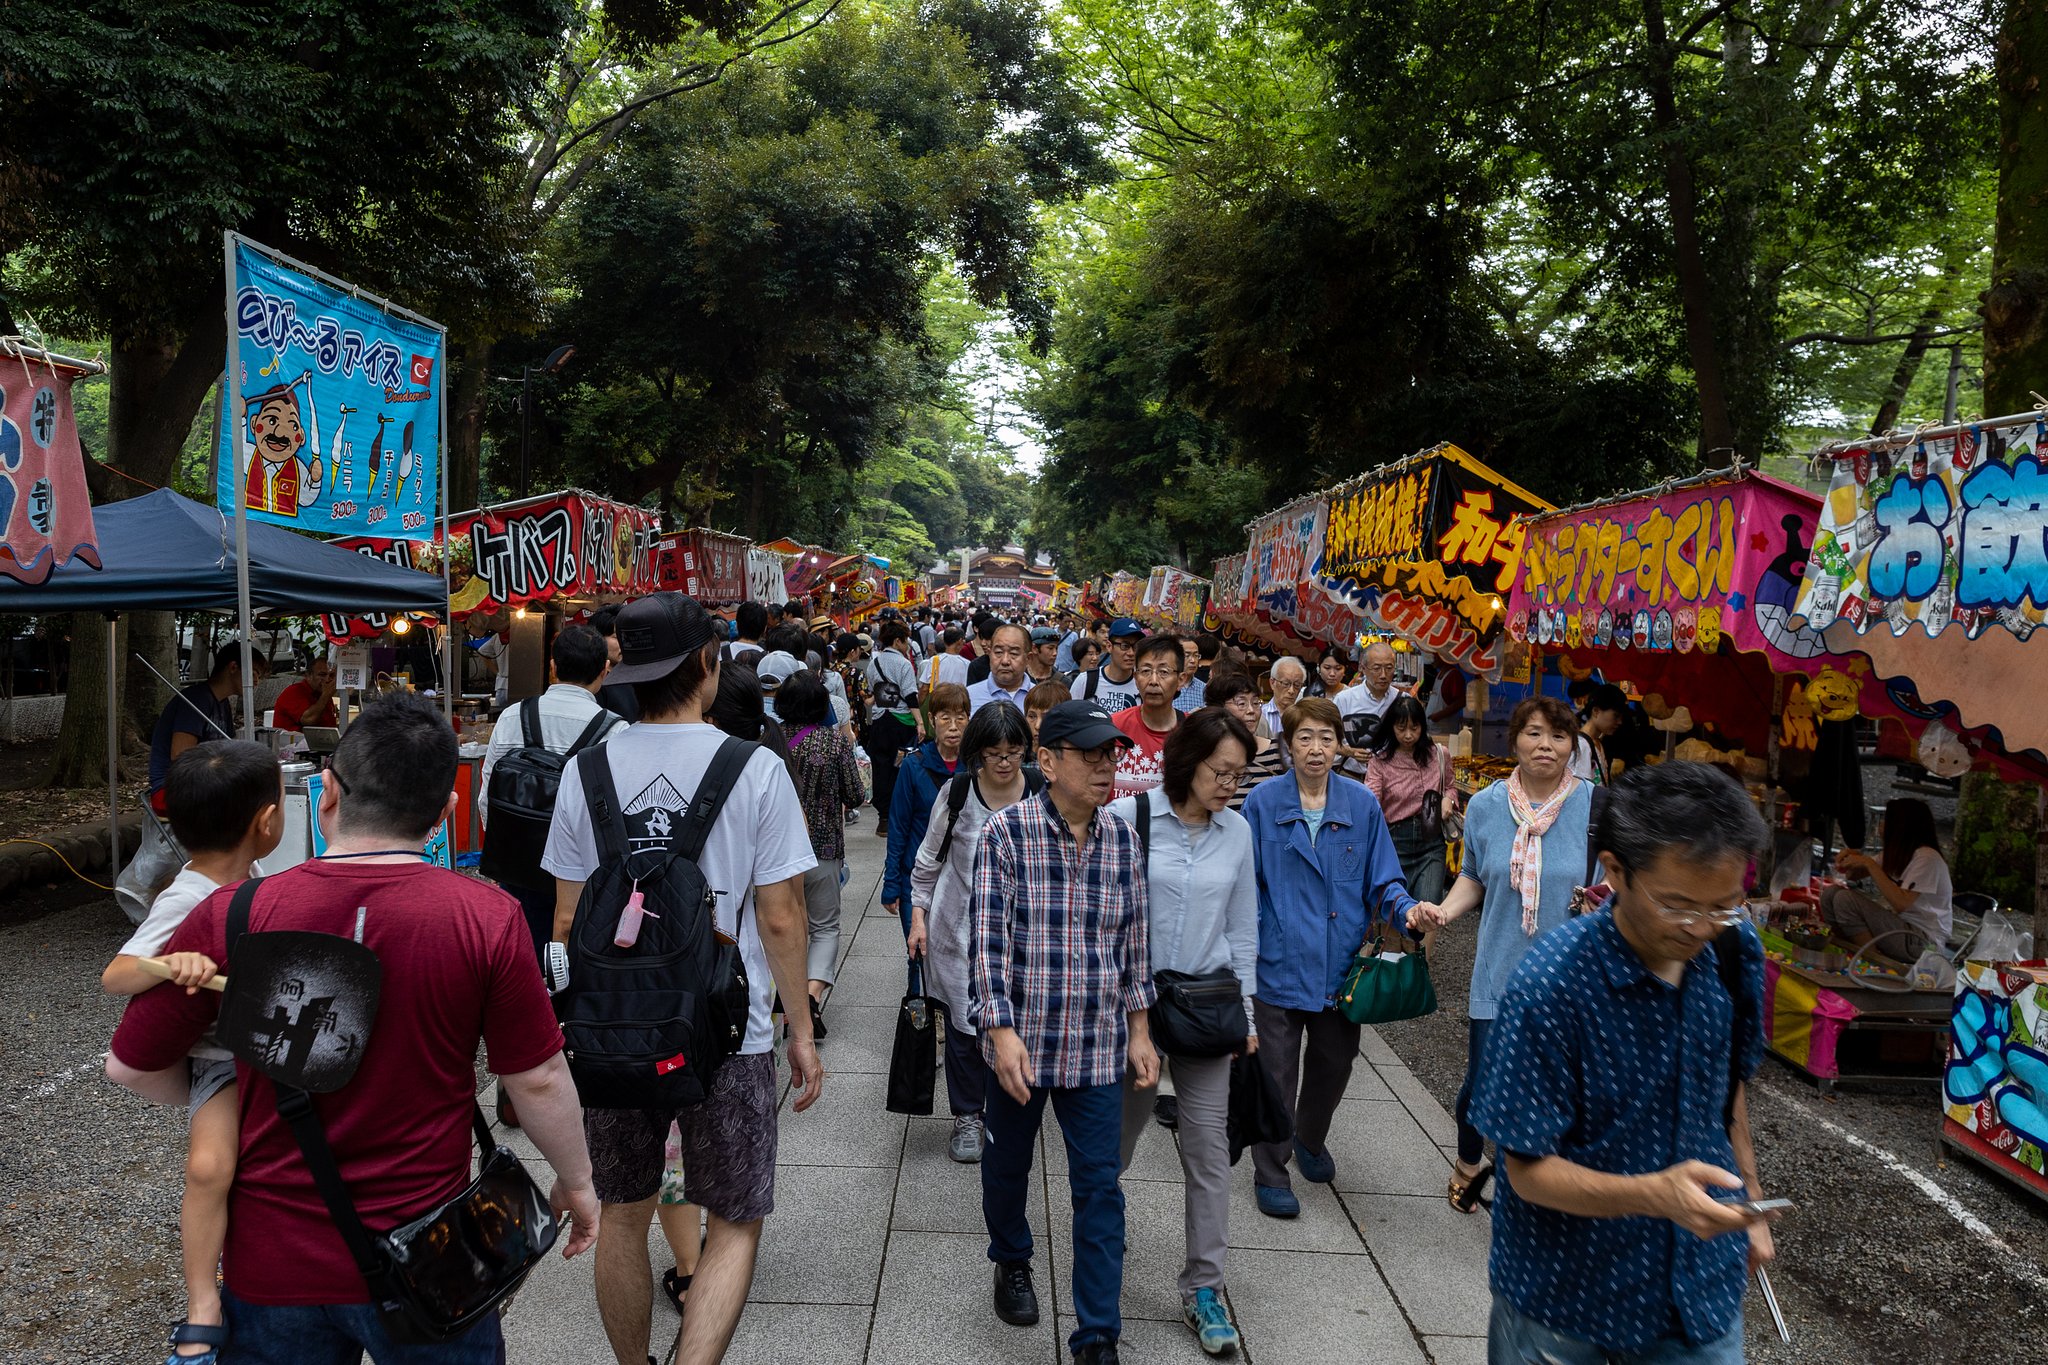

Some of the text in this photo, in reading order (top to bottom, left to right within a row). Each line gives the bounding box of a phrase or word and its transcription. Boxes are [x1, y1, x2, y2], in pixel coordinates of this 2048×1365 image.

[343, 441, 353, 494] バニラ
[381, 450, 395, 499] チョコ
[414, 454, 423, 505] ミックス
[331, 500, 357, 519] 300円
[367, 505, 388, 525] 300円
[402, 512, 427, 531] 500円
[471, 506, 577, 603] ケバブ
[1524, 497, 1736, 608] キャラクターすくい
[1107, 691, 1124, 700] THE
